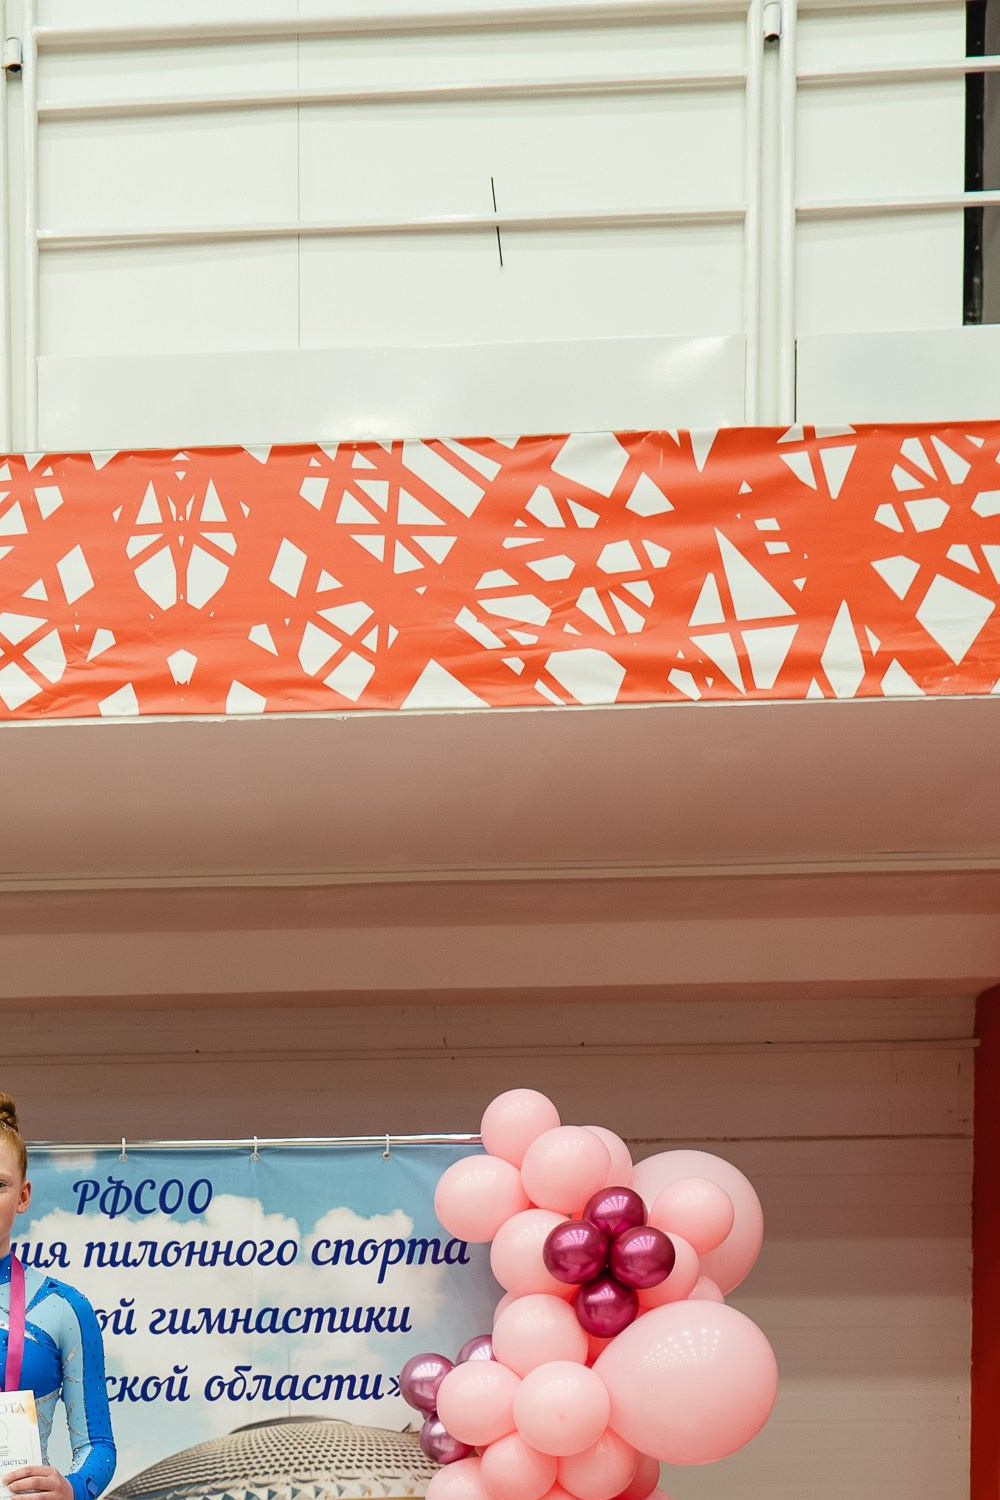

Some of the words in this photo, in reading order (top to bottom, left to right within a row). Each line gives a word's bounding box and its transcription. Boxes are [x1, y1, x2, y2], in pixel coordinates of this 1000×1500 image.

[72, 1175, 213, 1219] РФСОО
[83, 1239, 298, 1268] пилонного
[311, 1238, 470, 1284] спорта
[149, 1306, 413, 1335] гимнастики
[204, 1365, 402, 1402] области»
